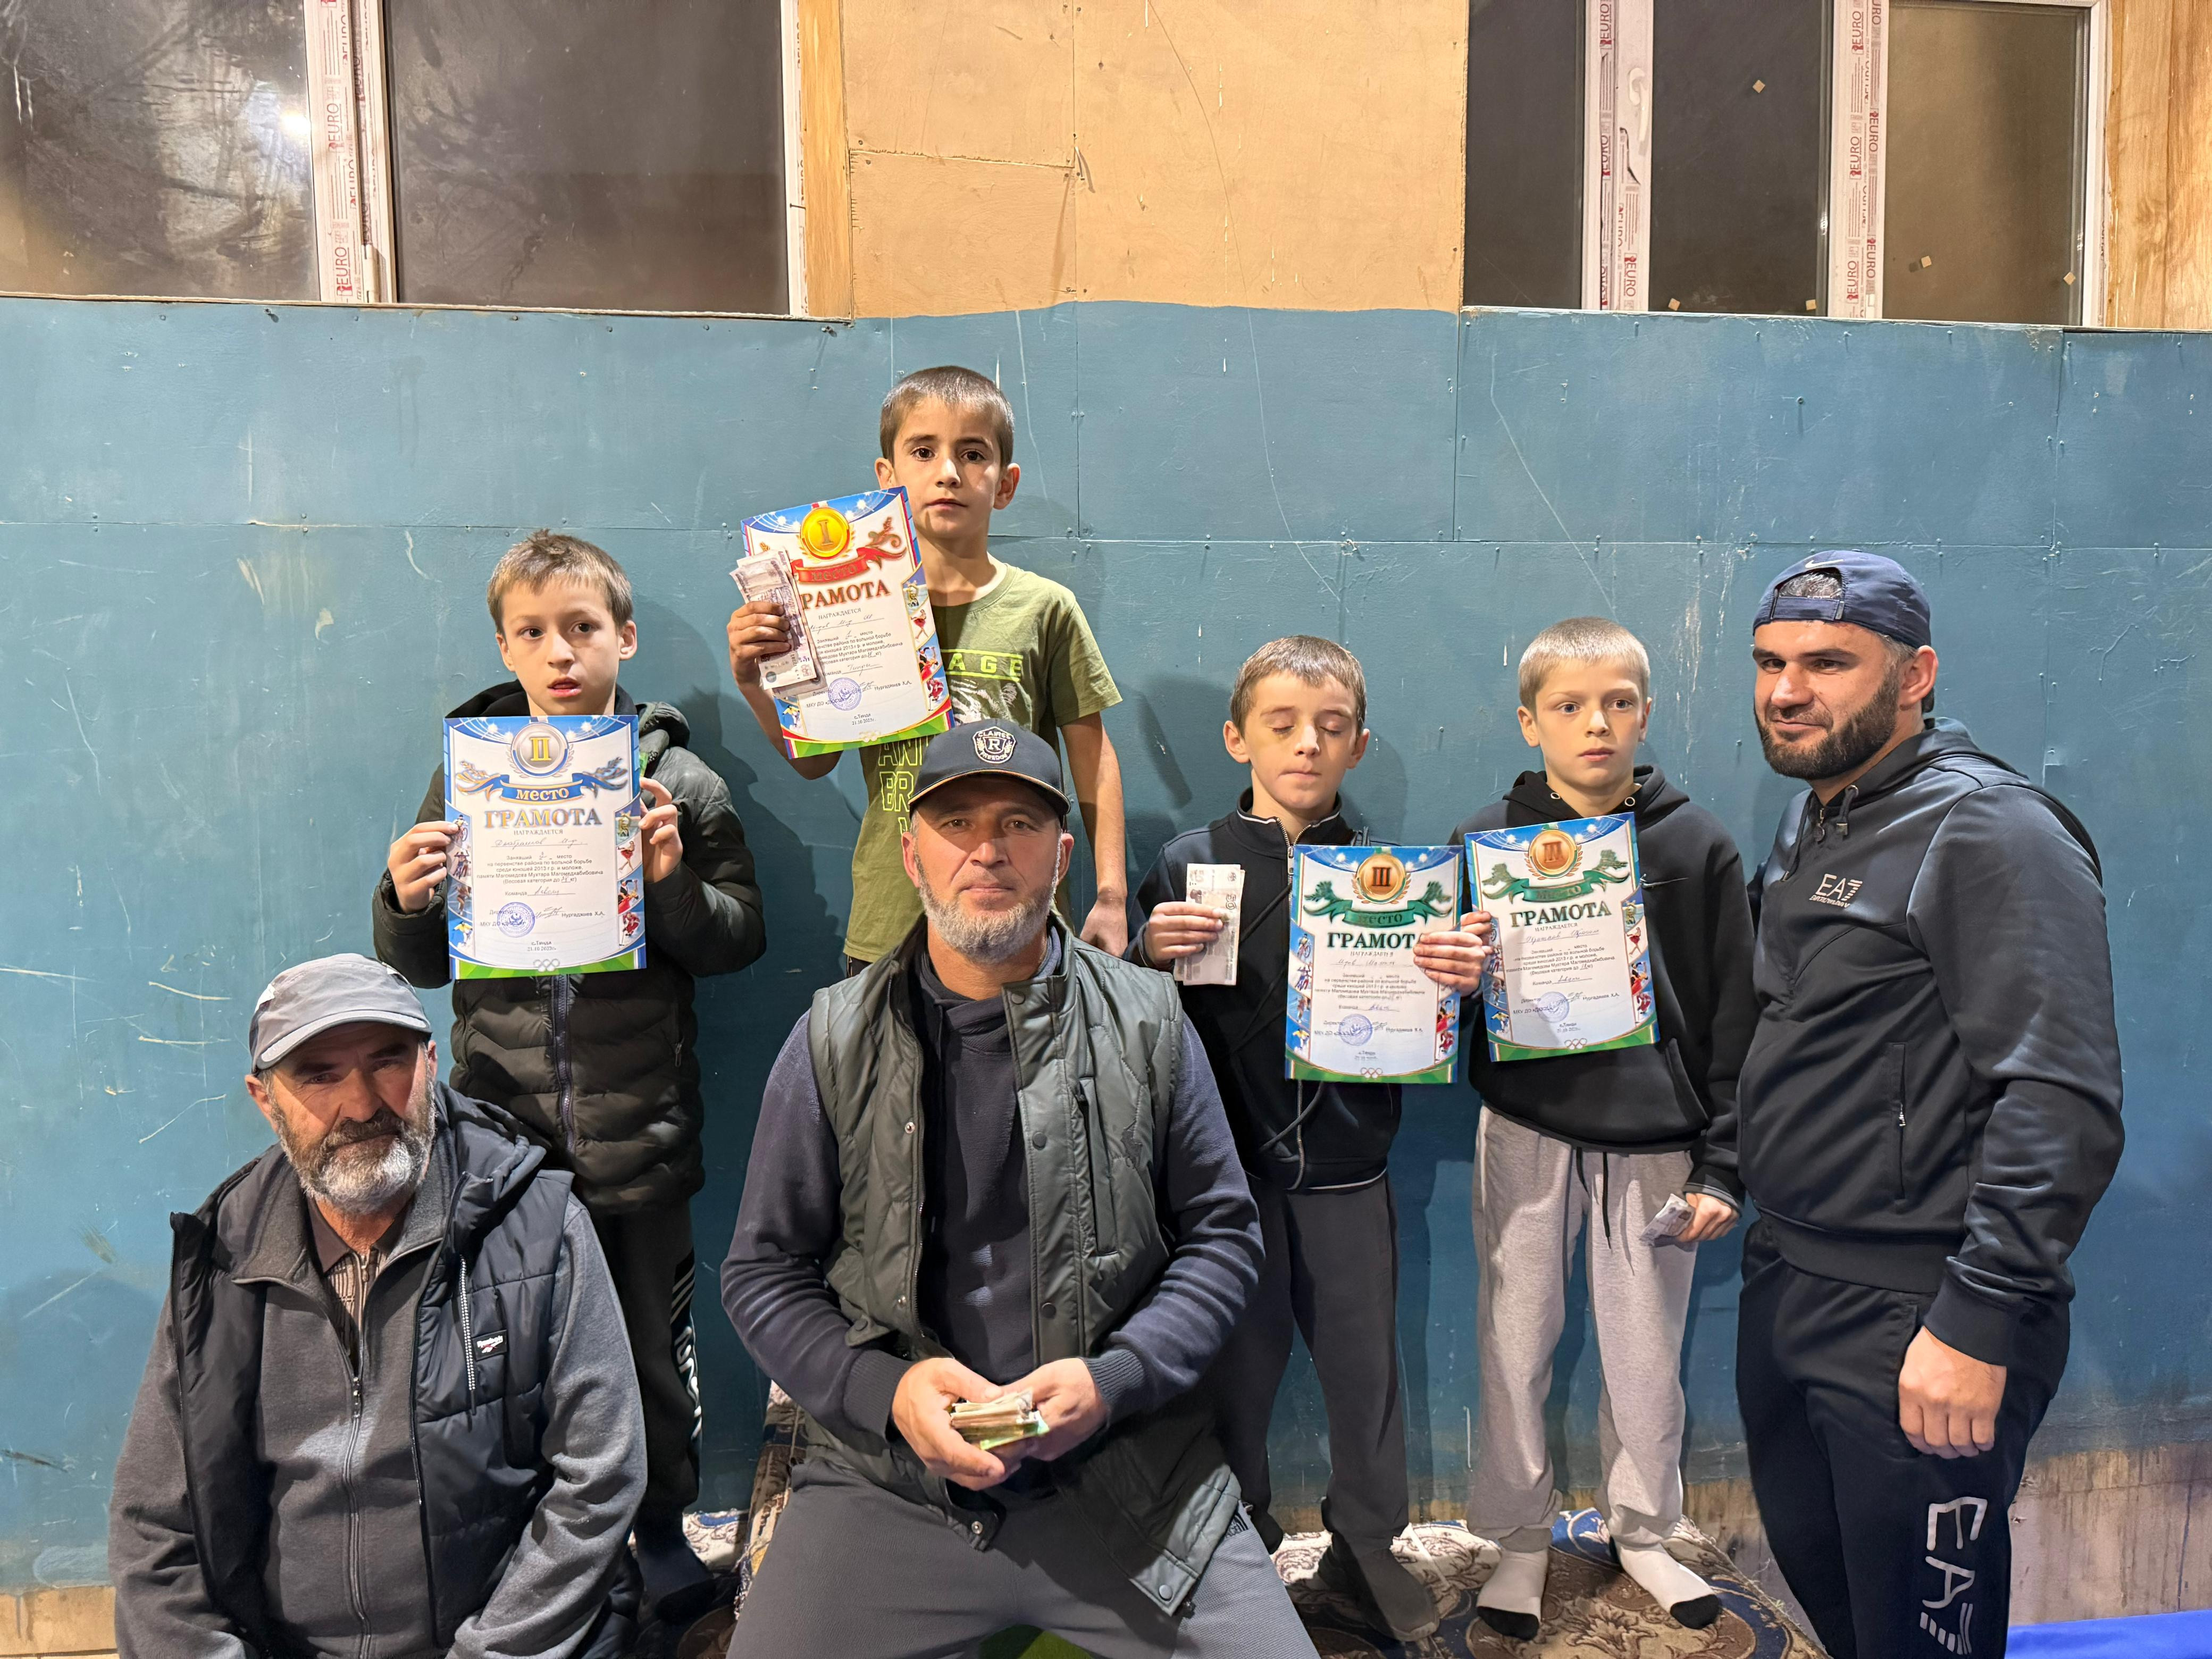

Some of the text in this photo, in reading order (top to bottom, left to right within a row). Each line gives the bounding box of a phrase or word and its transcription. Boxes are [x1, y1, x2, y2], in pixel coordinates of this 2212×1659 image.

[1600, 4, 1610, 39] EURO
[1872, 0, 1881, 25] URO
[1852, 11, 1862, 45] EURO
[326, 103, 340, 141] EURO
[1869, 118, 1879, 152] EURO
[1850, 136, 1860, 172] EURO
[334, 247, 348, 286] EURO
[1866, 244, 1876, 279] EURO
[1626, 263, 1637, 297] EURO
[1847, 260, 1857, 295] EURO
[800, 579, 891, 610] РАМОТА
[818, 608, 861, 620] НАГРАЖДАЕТСЯ
[988, 738, 1001, 750] R
[516, 788, 569, 801] место
[485, 808, 602, 829] ГРАМОТА
[1815, 873, 1863, 901] EA7
[1226, 894, 1237, 910] 50
[1510, 900, 1612, 928] ГРАМОТА
[1327, 932, 1423, 949] ГРАМОТ
[1535, 923, 1578, 932] НАГРАЖДАЕТСЯ
